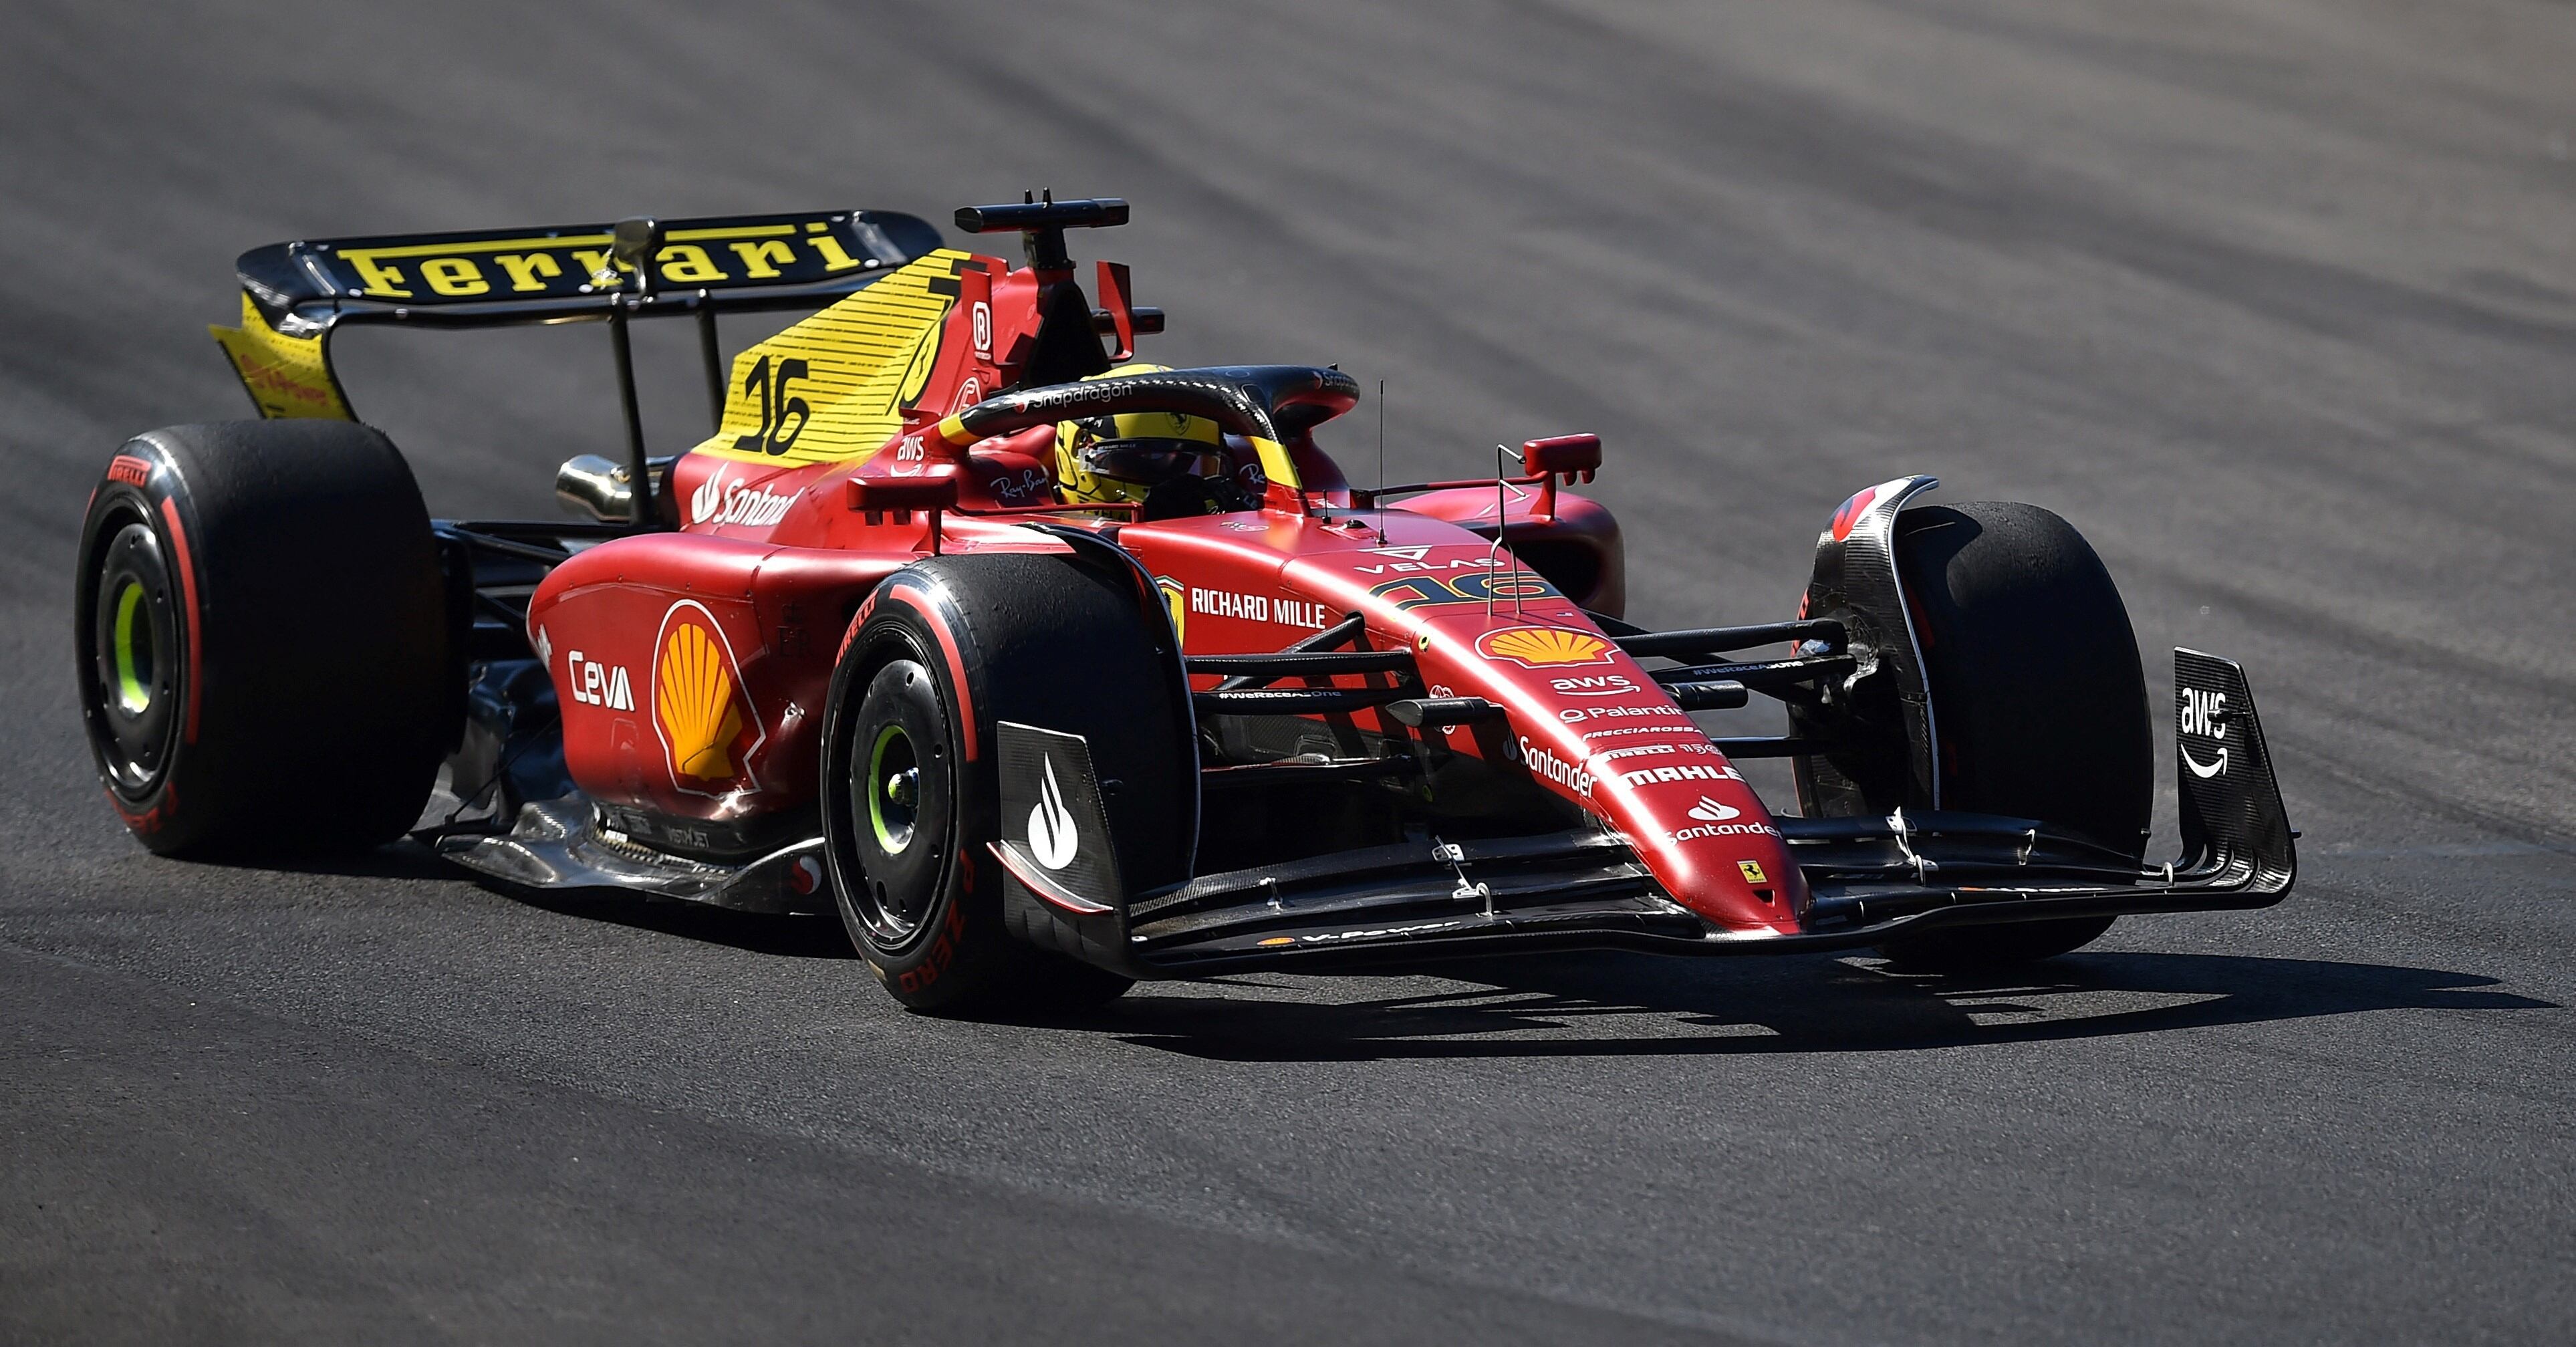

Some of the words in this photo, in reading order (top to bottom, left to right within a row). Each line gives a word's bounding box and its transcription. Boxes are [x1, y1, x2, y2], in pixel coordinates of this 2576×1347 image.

[337, 222, 860, 298] Ferrari
[733, 355, 810, 456] 16
[1033, 384, 1132, 408] Snapdragon
[897, 436, 924, 461] aws
[108, 455, 152, 487] PIRELLI
[990, 469, 1046, 498] Ray-Ban
[1354, 556, 1505, 574] VELAS
[1367, 570, 1567, 613] 16
[1192, 588, 1267, 622] RICHARD
[1273, 599, 1326, 629] MILLE
[835, 588, 880, 668] PIRELLI
[1549, 675, 1631, 691] aws
[1587, 704, 1682, 719] Palantir
[2181, 687, 2226, 739] aws
[1520, 735, 1599, 798] Santander
[1616, 765, 1747, 789] MAHLE
[1664, 822, 1784, 846] Santander
